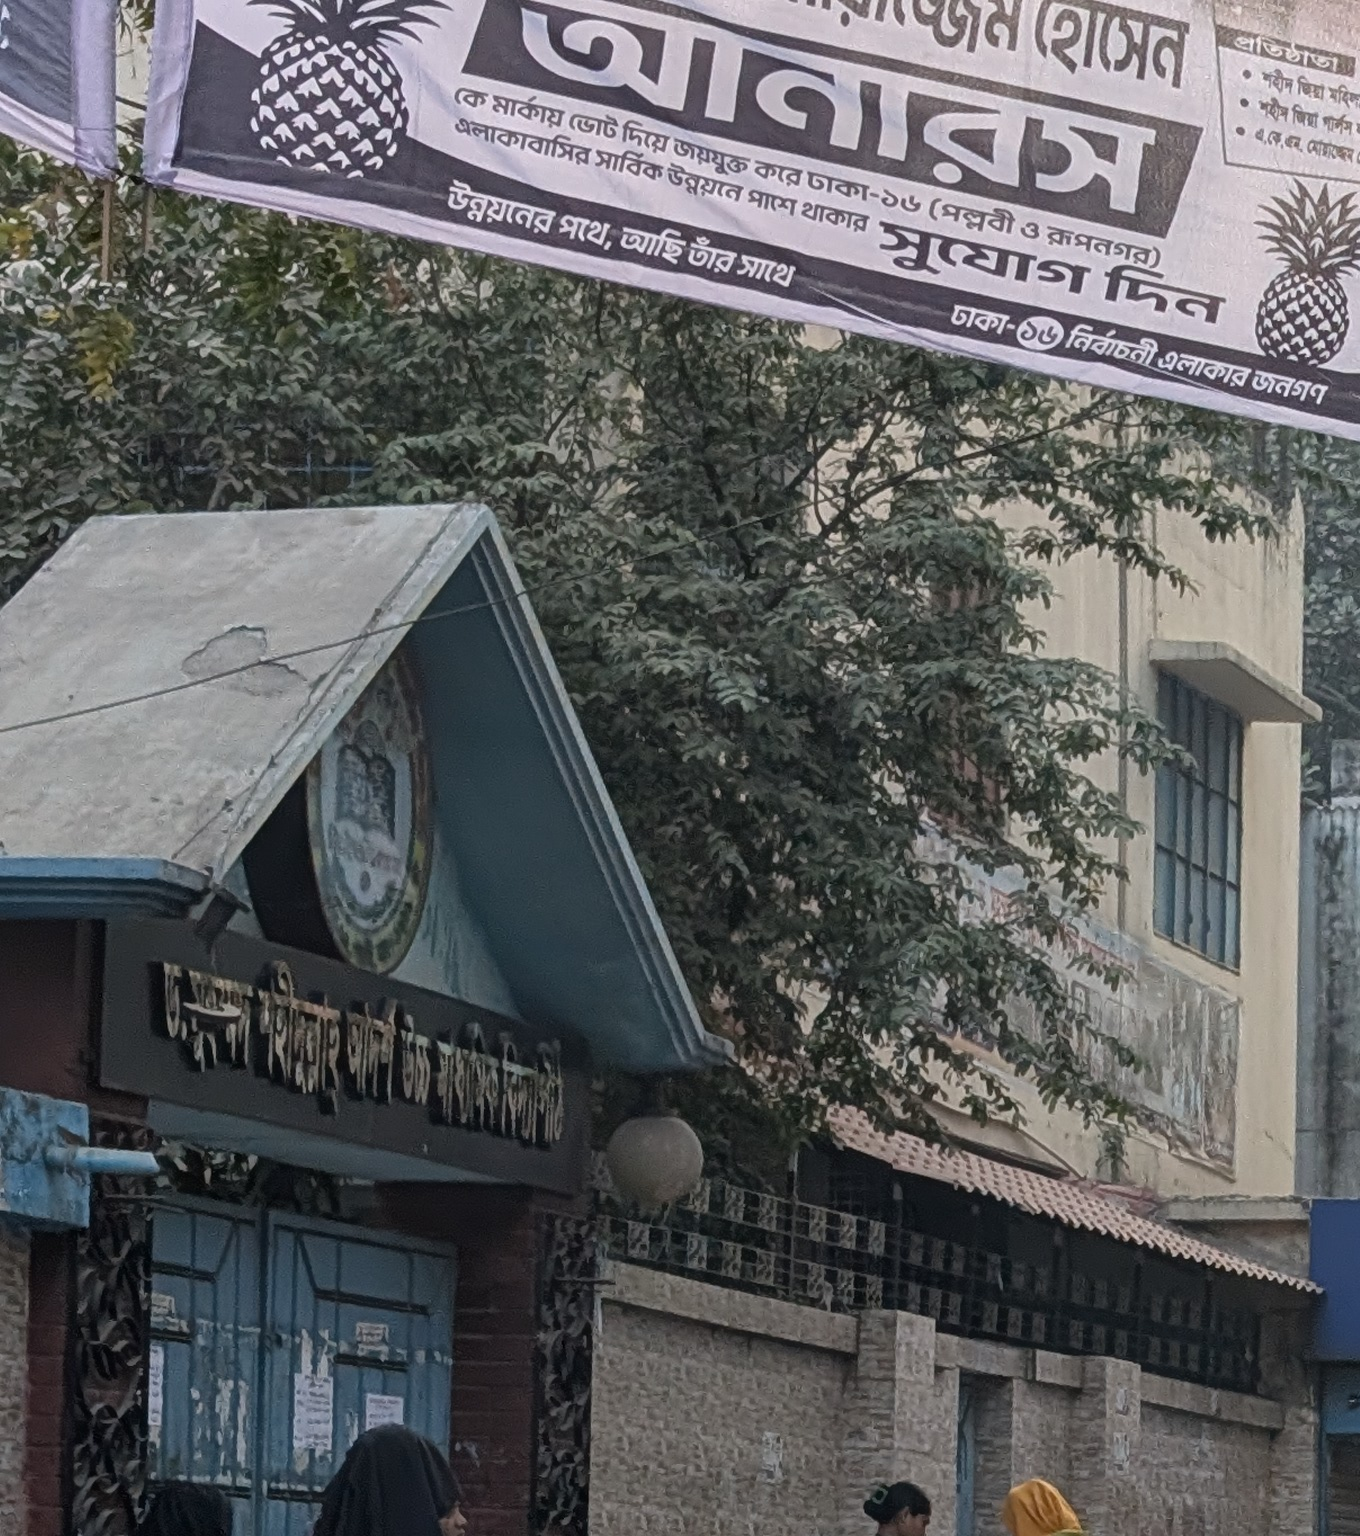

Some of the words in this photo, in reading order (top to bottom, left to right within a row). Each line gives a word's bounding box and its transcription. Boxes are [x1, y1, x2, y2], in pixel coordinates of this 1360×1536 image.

[521, 3, 1160, 216] আনারস
[1034, 0, 1190, 89] হোসেন
[453, 86, 488, 109] কে
[491, 95, 565, 129] মার্কায়
[569, 113, 622, 141] ভোট
[621, 119, 671, 155] দিয়ে
[673, 136, 750, 177] জয়যুক্ত
[753, 158, 803, 188] করে
[807, 168, 923, 213] ঢাকা-১৬
[1019, 220, 1042, 242] ও
[454, 116, 591, 167] এলাকাবাসির
[594, 145, 664, 182] সার্বিক
[667, 163, 744, 204] উন্নয়নে
[746, 186, 799, 218] পাশে
[800, 197, 871, 234] থাকার
[877, 220, 1093, 295] সুযোগ
[1103, 263, 1230, 326] দিন
[446, 180, 557, 236] উন্নয়নের
[619, 226, 688, 266] আছি
[686, 235, 738, 274] তাঁর
[736, 257, 797, 289] সাথে
[1065, 325, 1160, 370] নির্বাচনী
[1156, 350, 1252, 389] এলাকার
[1250, 368, 1330, 407] জনগণ
